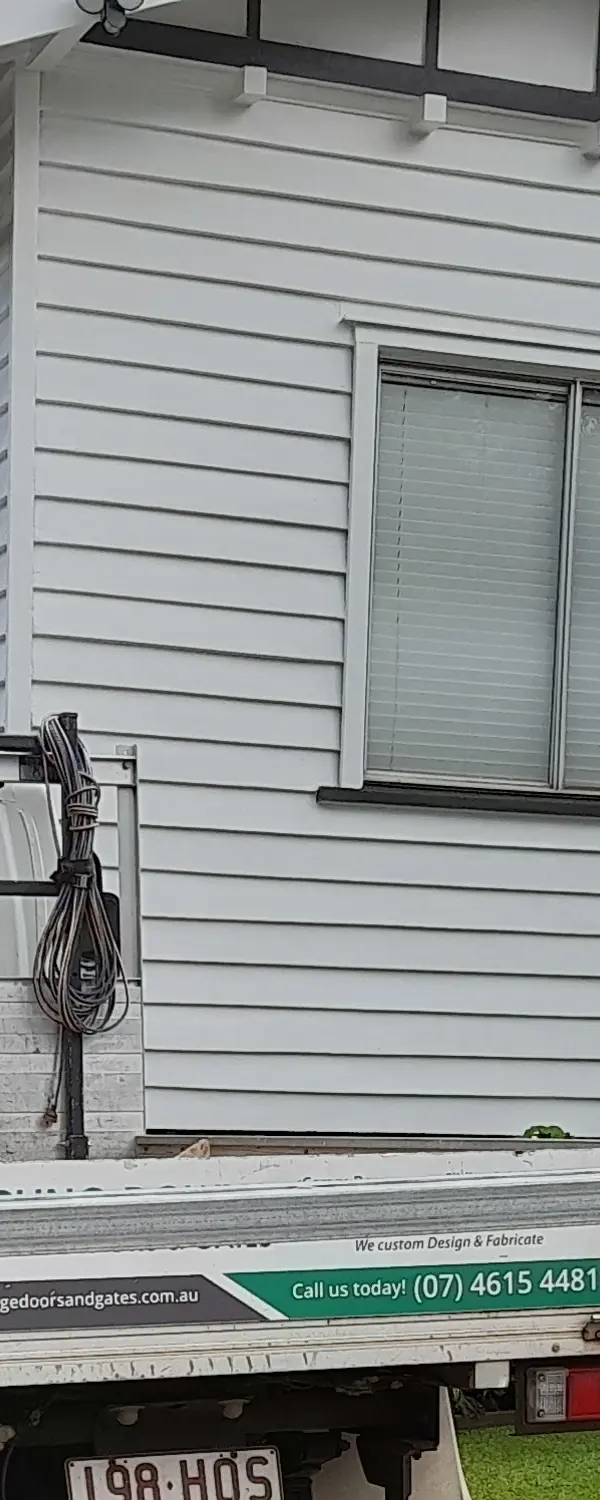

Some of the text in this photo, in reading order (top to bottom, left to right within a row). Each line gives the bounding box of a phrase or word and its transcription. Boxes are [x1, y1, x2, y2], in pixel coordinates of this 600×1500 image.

[355, 1233, 544, 1252] We custom Design & Fabricate
[292, 1267, 597, 1303] Call us today! (07) 4615 4481
